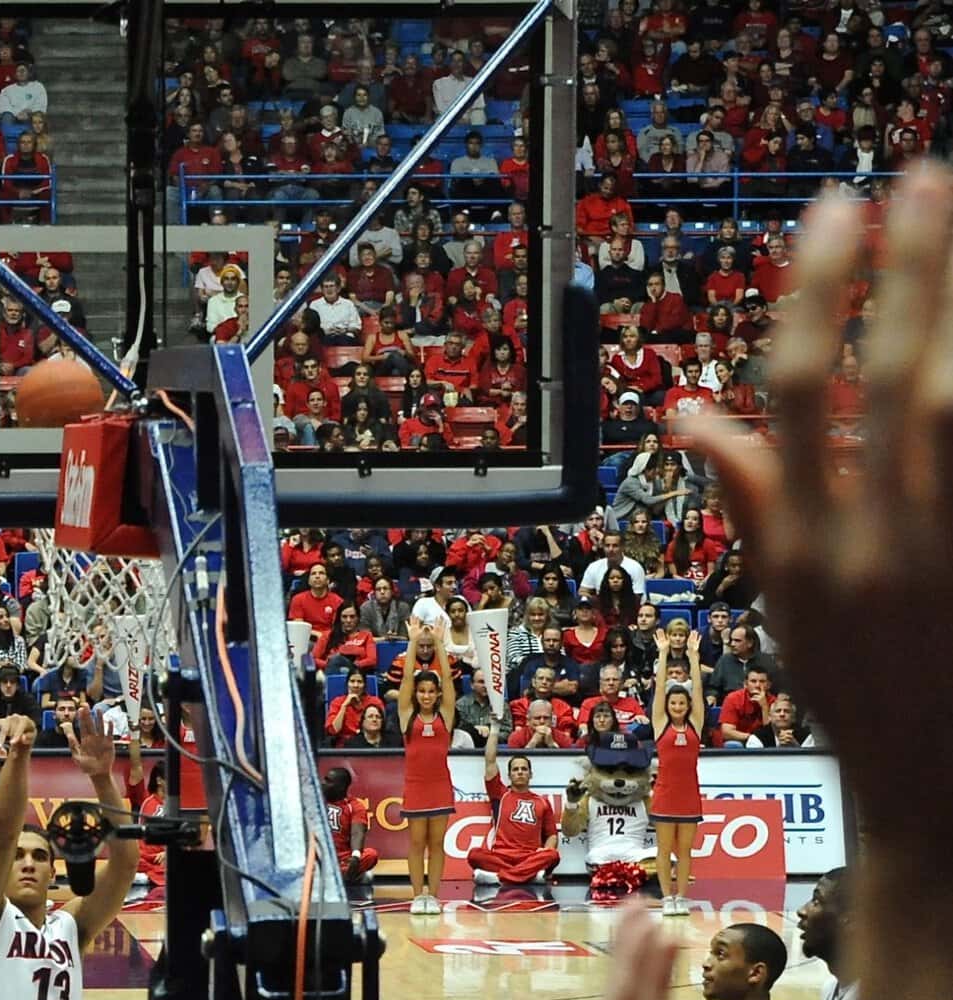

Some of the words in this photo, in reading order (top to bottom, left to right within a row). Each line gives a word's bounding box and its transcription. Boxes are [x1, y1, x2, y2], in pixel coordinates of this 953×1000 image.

[488, 632, 504, 695] ARIZONA
[127, 663, 140, 701] ARIZ
[511, 800, 537, 824] A
[596, 805, 638, 817] ARIZONA
[607, 818, 625, 835] 12
